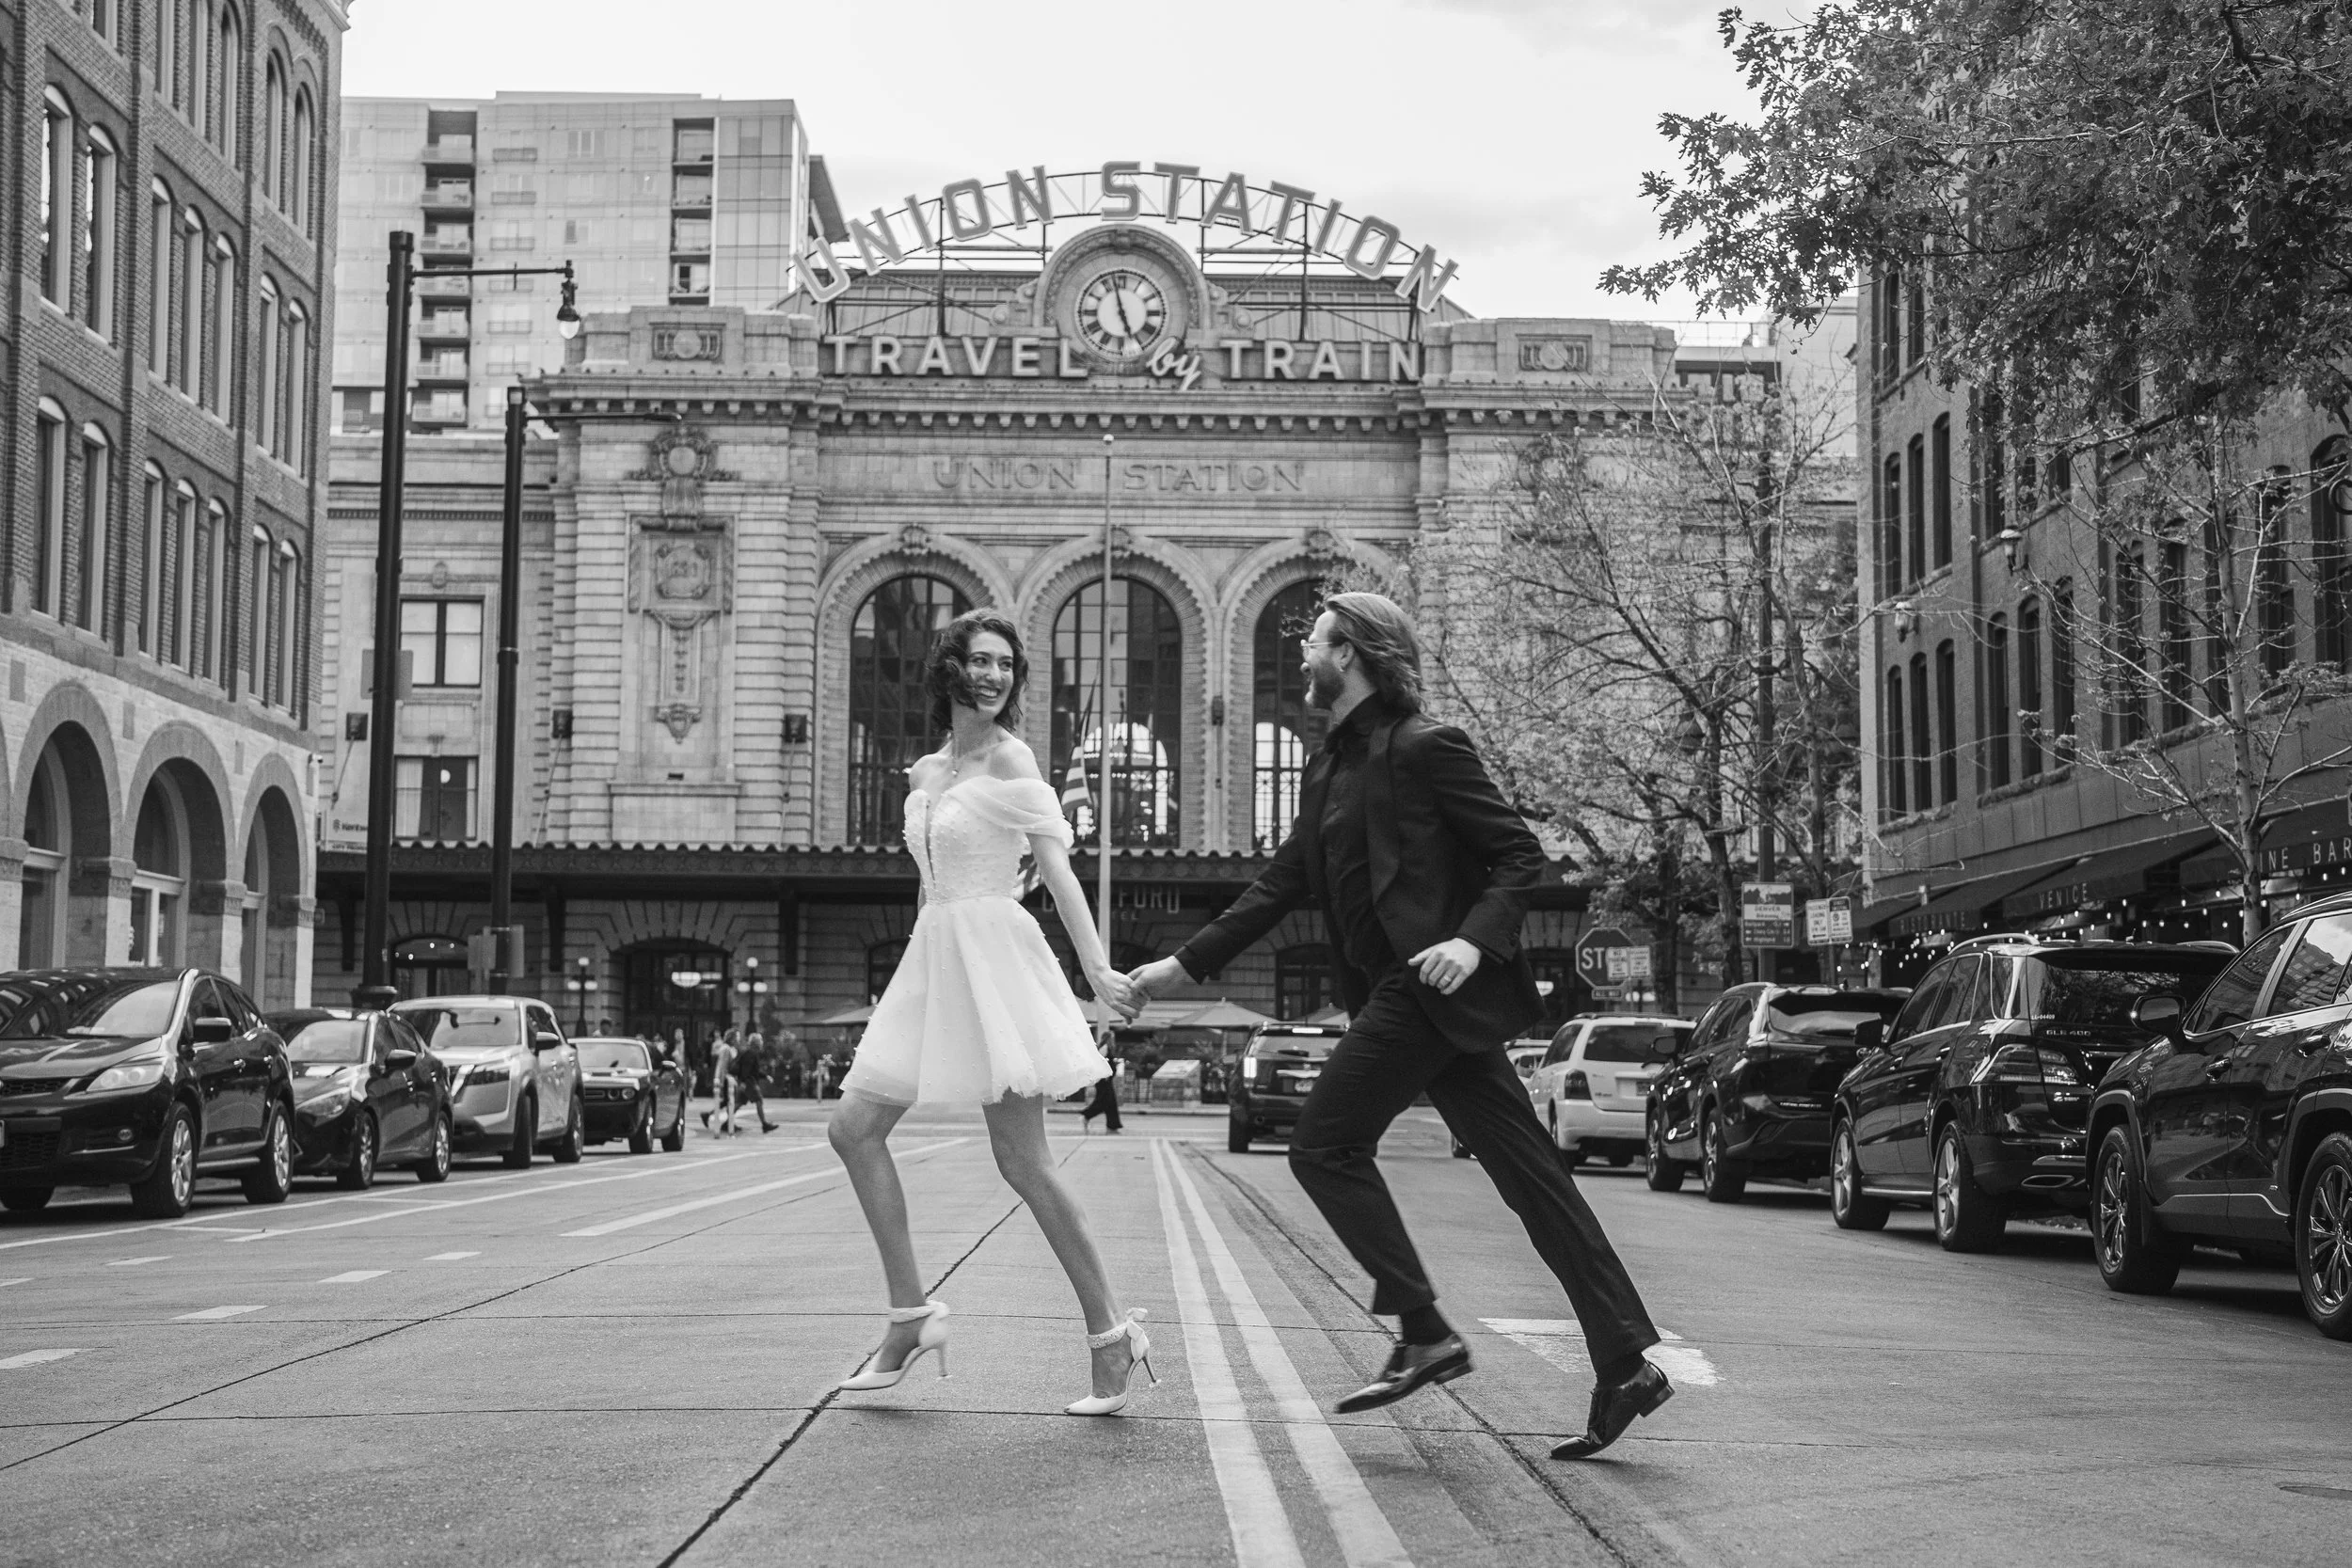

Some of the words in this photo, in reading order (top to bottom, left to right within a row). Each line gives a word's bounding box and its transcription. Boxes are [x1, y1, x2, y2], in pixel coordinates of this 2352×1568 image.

[792, 165, 1054, 303] UNION
[1101, 161, 1458, 314] STATION
[823, 335, 1088, 377] TRAVEL
[1146, 336, 1201, 390] by
[1220, 339, 1419, 380] TRAIN
[932, 461, 1080, 491] UNION
[1123, 463, 1307, 493] STATION
[2259, 847, 2289, 874] INE
[2312, 837, 2352, 864] BAR
[2038, 882, 2089, 911] VENICE
[1581, 946, 1605, 970] ST
